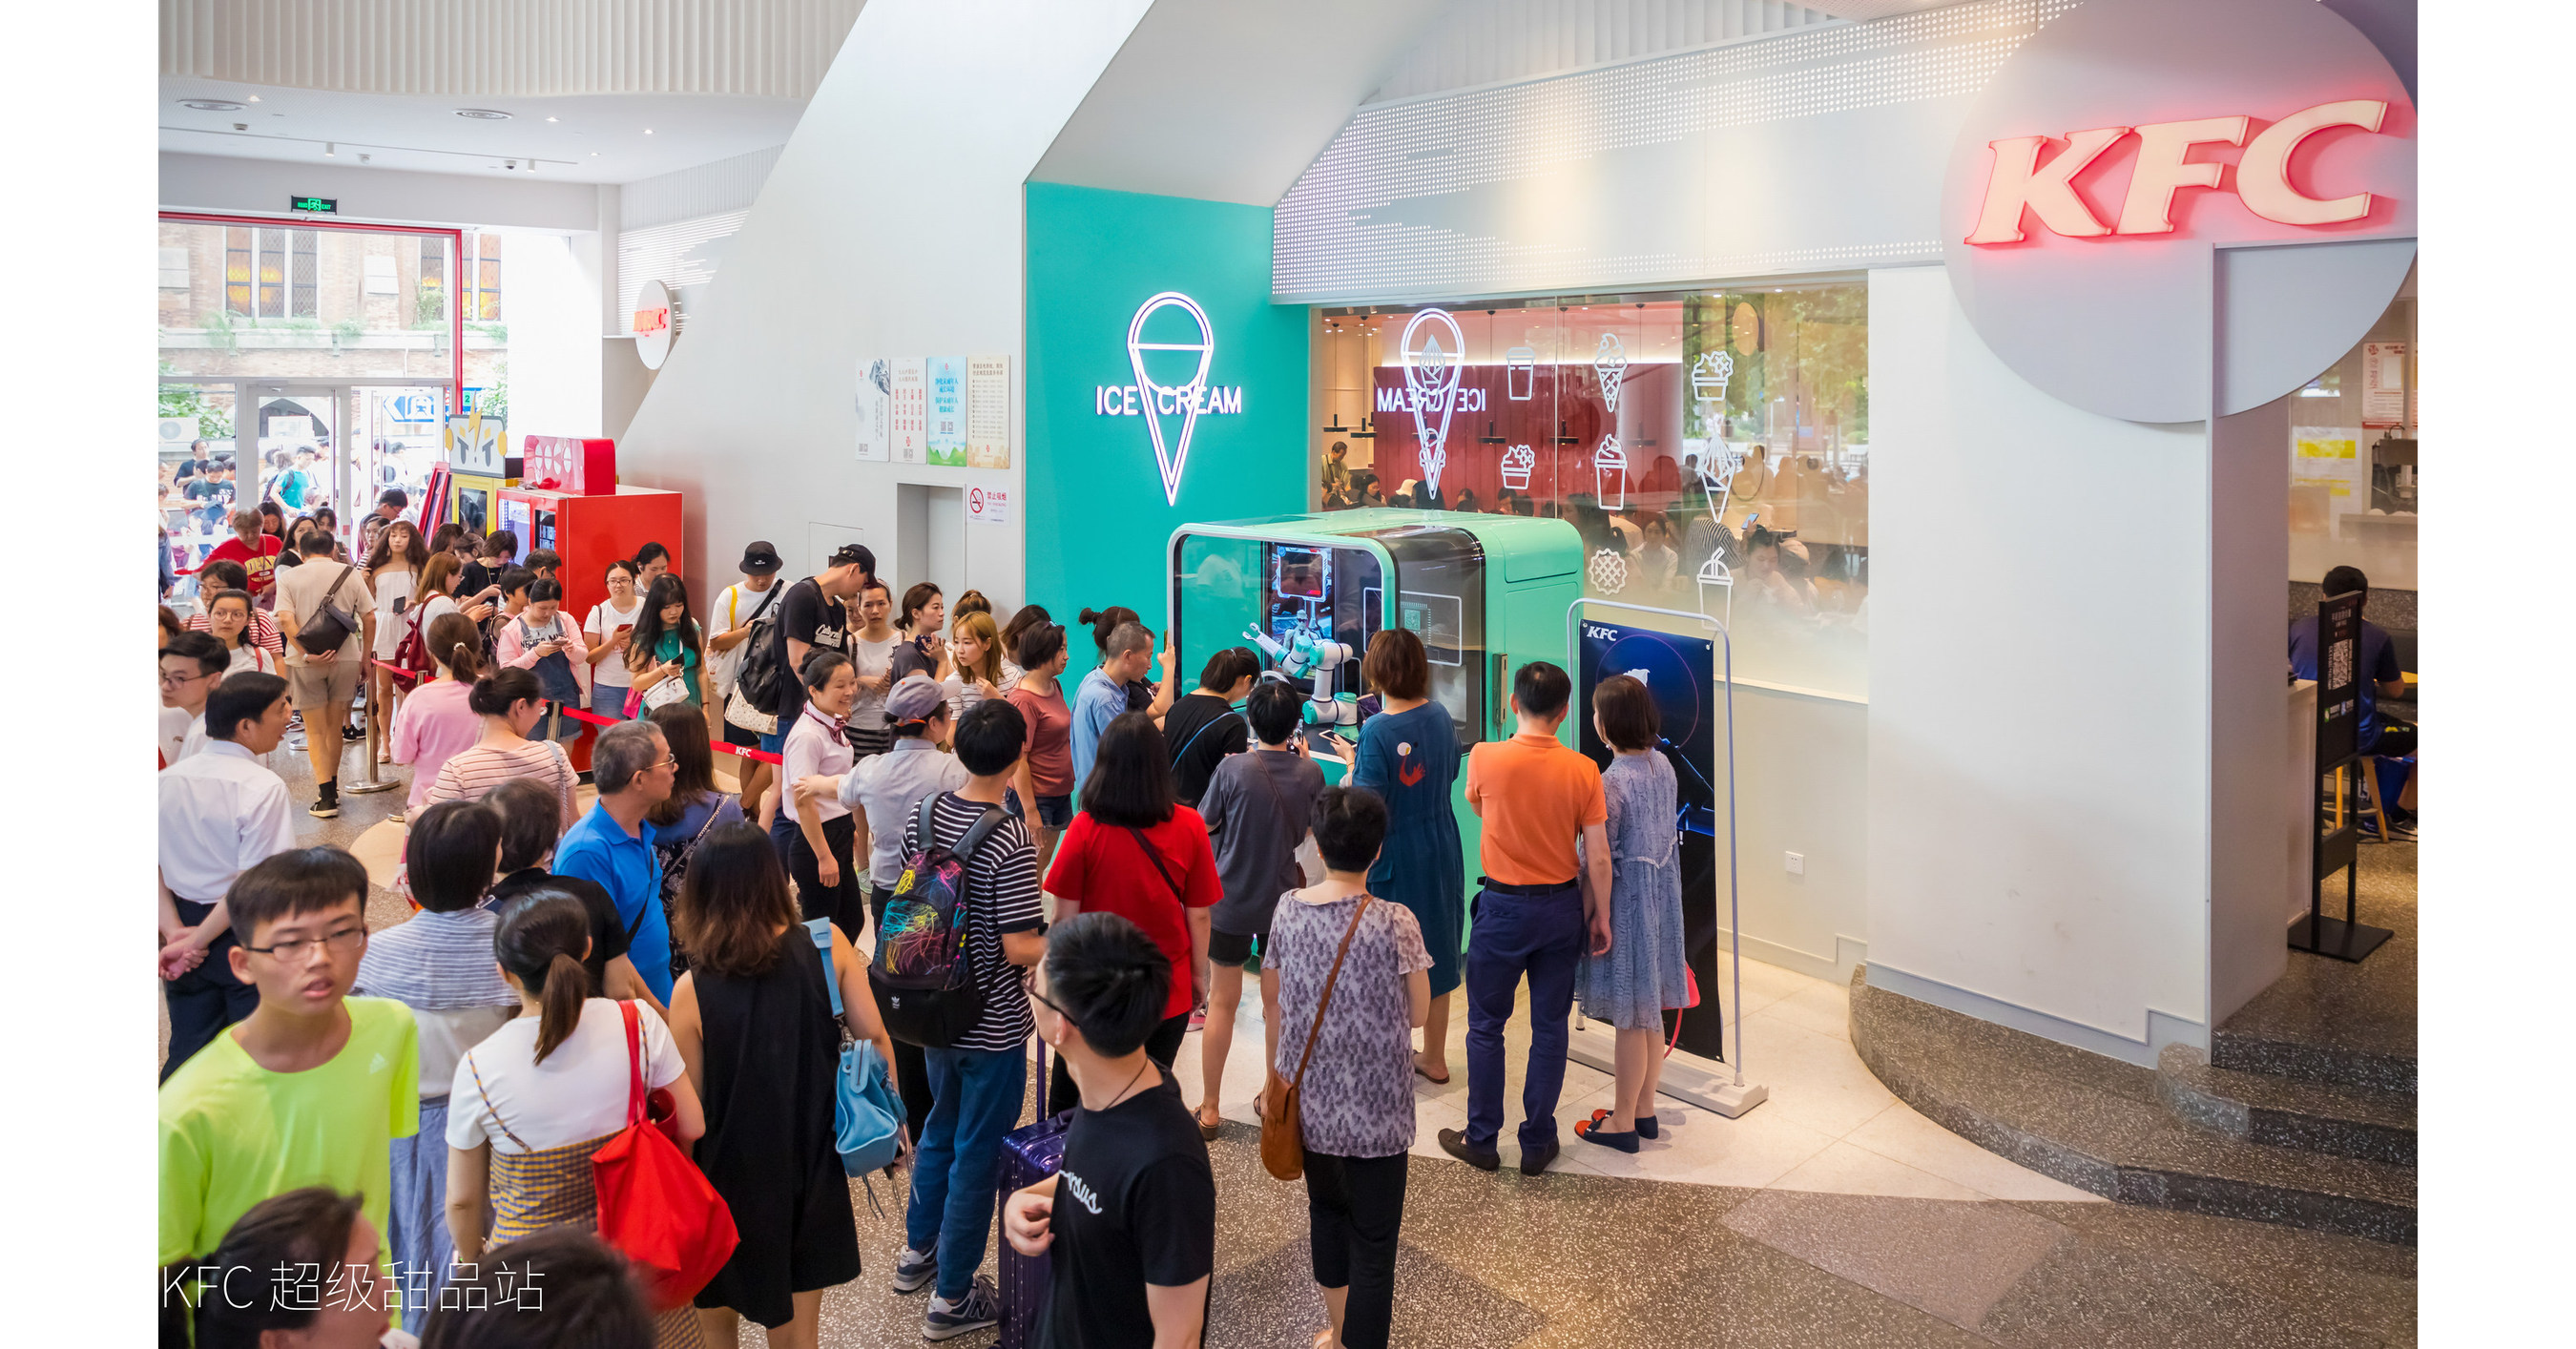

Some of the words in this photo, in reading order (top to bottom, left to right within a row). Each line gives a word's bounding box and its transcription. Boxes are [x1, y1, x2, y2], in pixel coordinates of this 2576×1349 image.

[1963, 99, 2389, 245] KFC
[465, 394, 470, 403] 2
[1096, 385, 1138, 415] ICE
[1156, 385, 1242, 415] CREAM
[1587, 626, 1618, 641] KFC
[735, 746, 752, 758] KFC
